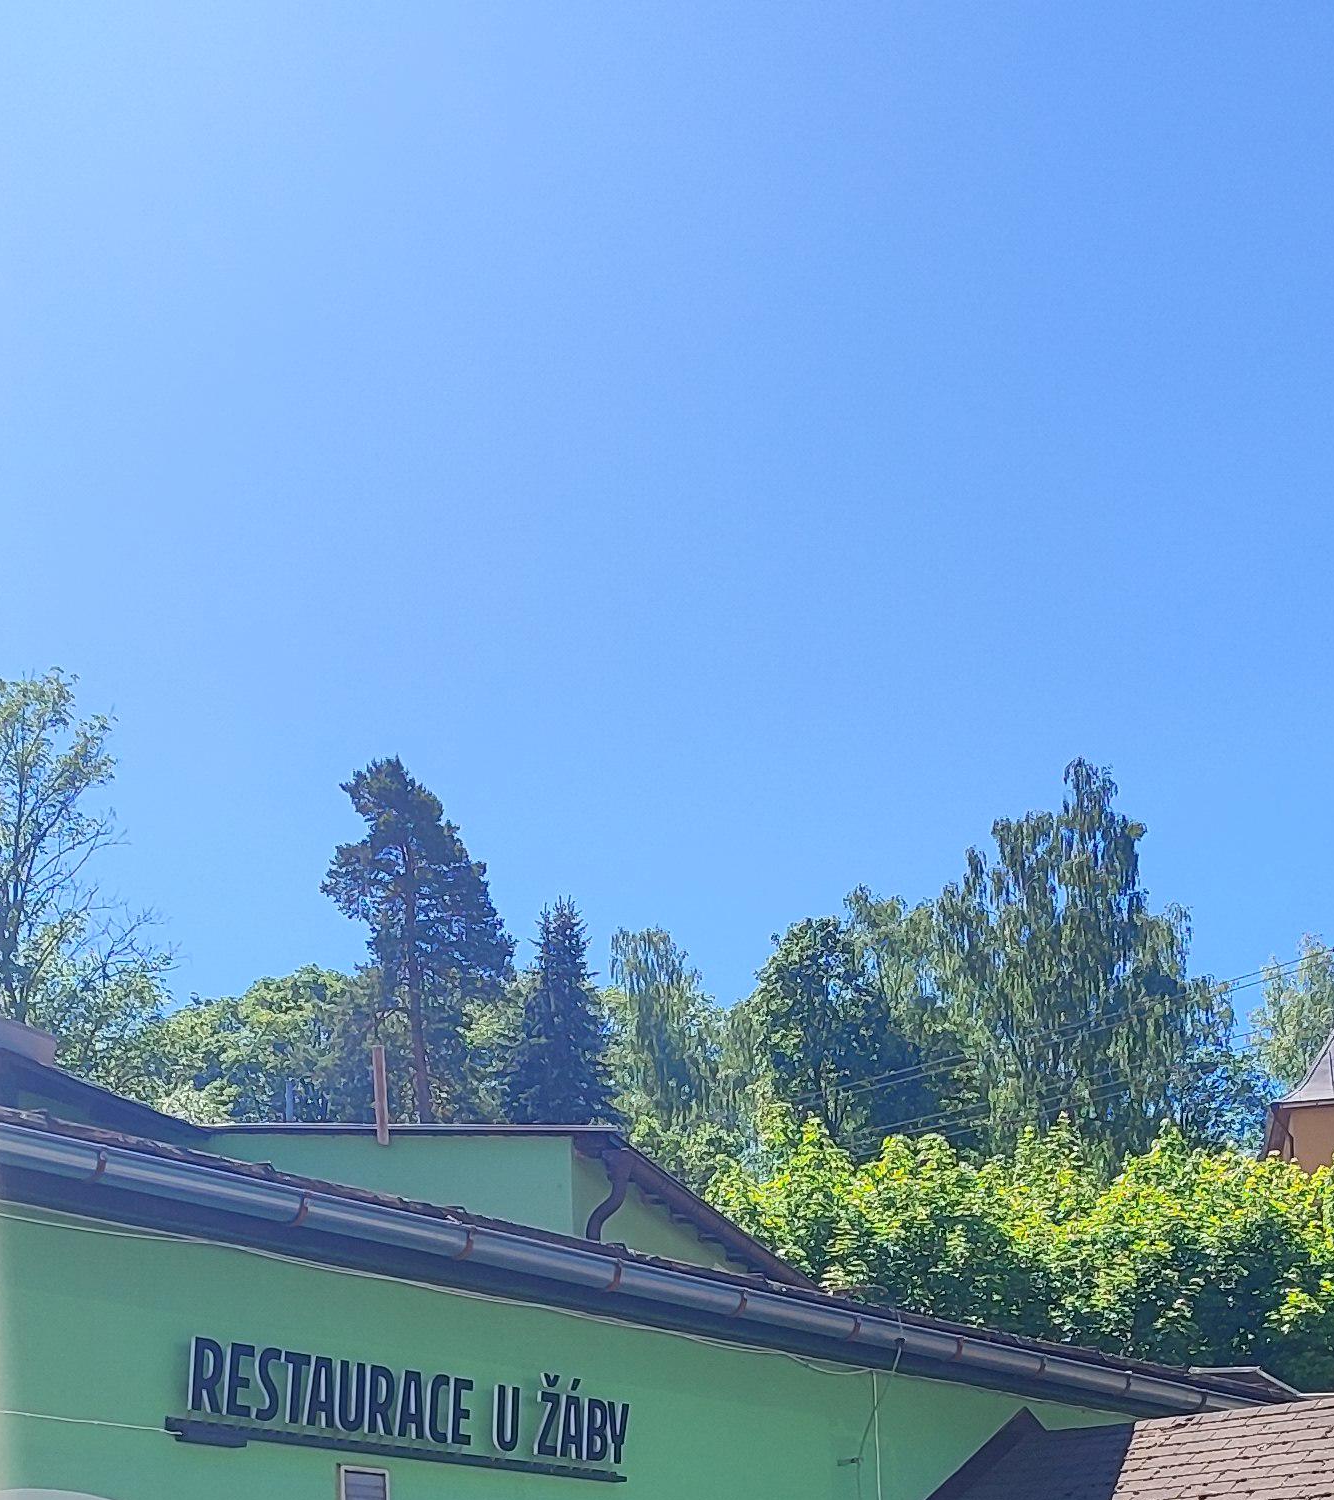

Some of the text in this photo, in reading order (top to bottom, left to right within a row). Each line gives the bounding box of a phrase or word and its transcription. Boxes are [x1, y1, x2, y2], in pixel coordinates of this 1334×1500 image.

[187, 1336, 629, 1464] RESTAURACE U ŽÁBY
